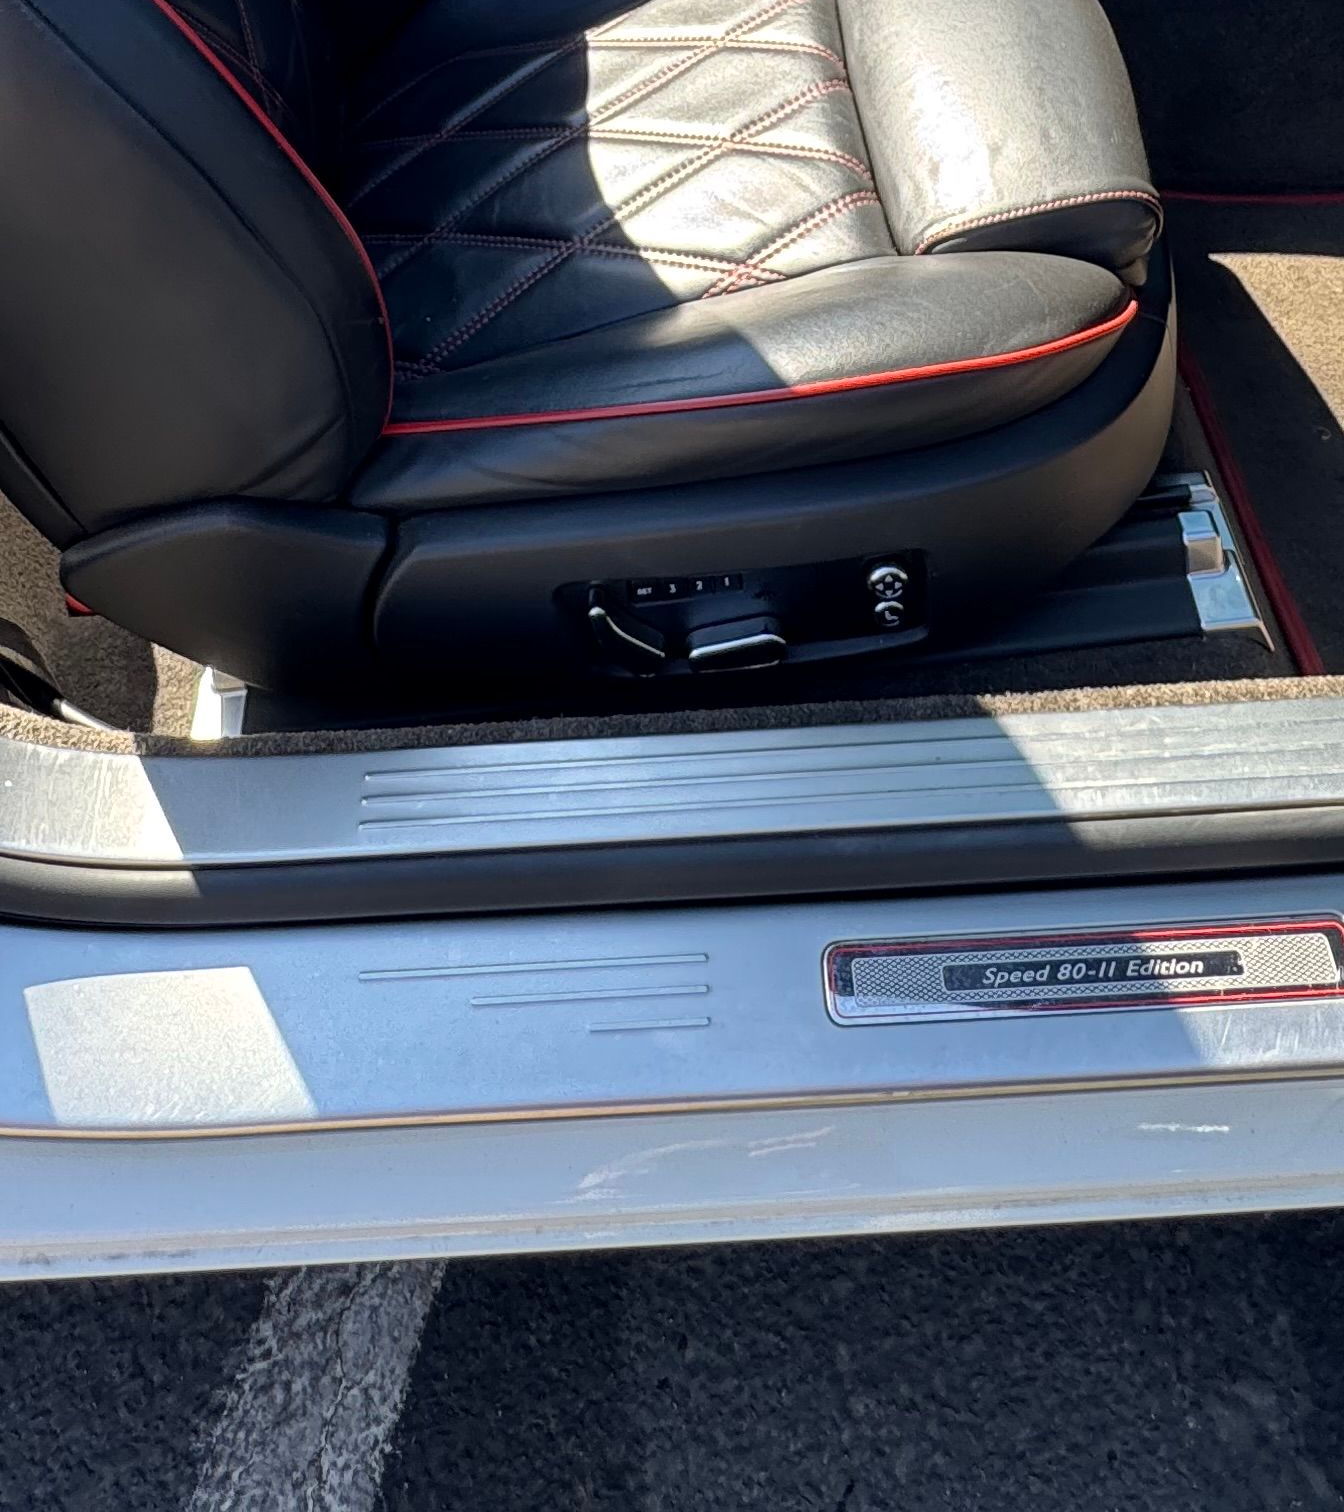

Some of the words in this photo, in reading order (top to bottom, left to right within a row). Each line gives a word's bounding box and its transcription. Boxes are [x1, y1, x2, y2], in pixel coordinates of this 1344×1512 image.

[669, 584, 676, 594] 3
[696, 580, 703, 591] 2
[724, 577, 730, 587] 1
[982, 964, 1050, 988] Speed
[1126, 958, 1204, 977] Edition
